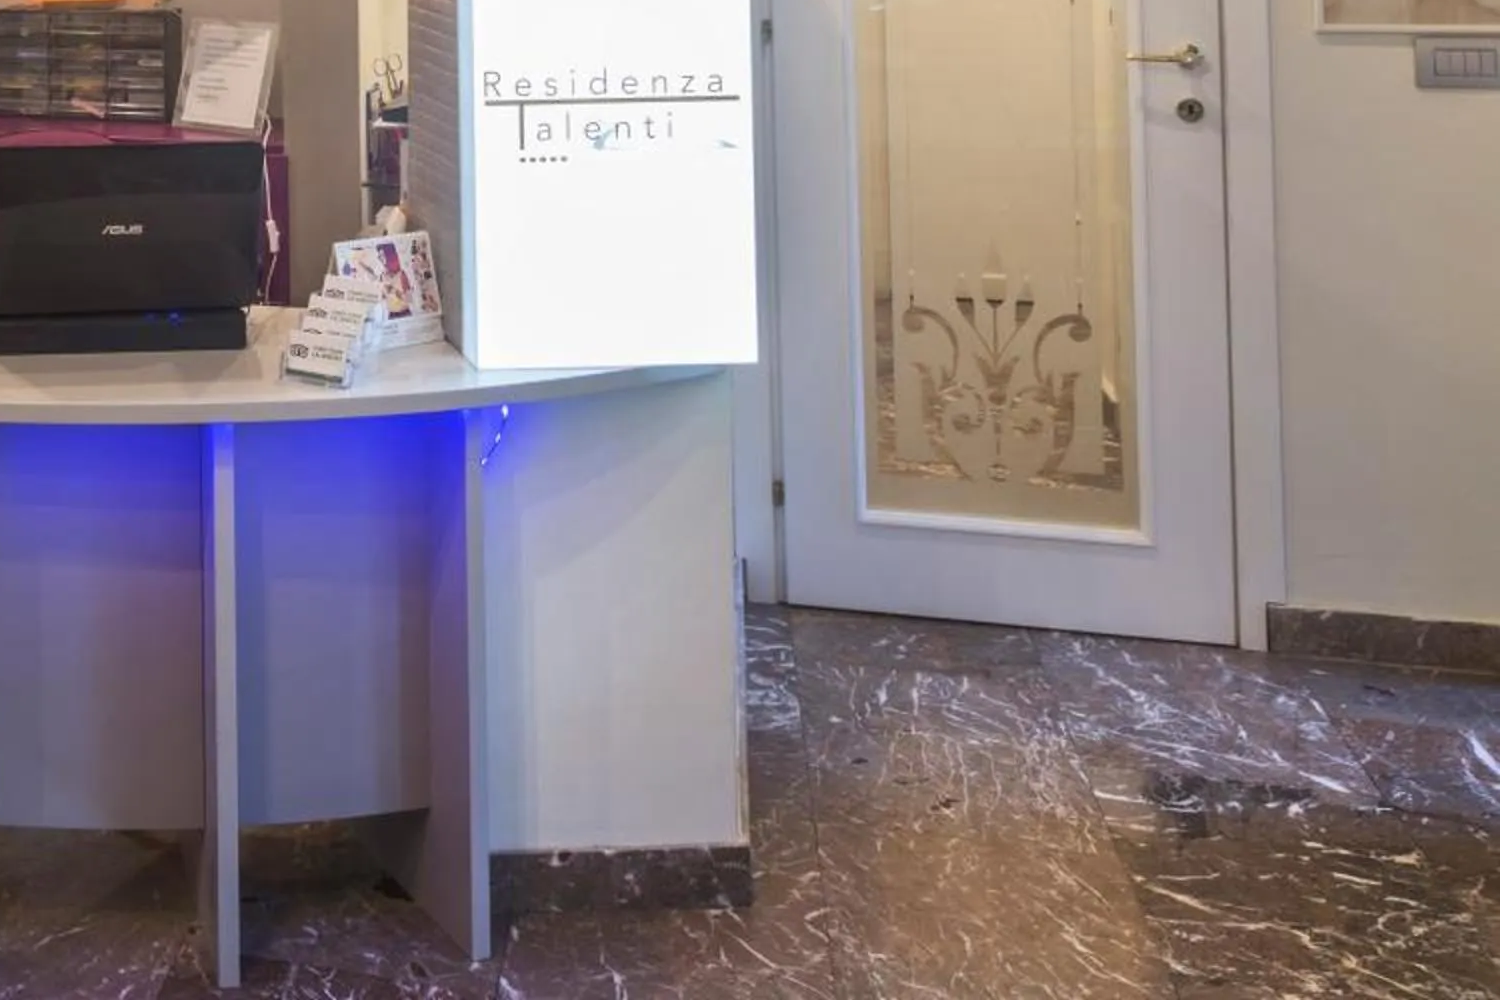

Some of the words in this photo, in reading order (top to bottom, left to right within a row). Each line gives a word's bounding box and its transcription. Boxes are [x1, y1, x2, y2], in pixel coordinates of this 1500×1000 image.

[482, 68, 725, 97] Residenza
[518, 100, 676, 150] Talenti
[101, 224, 144, 236] ASUS
